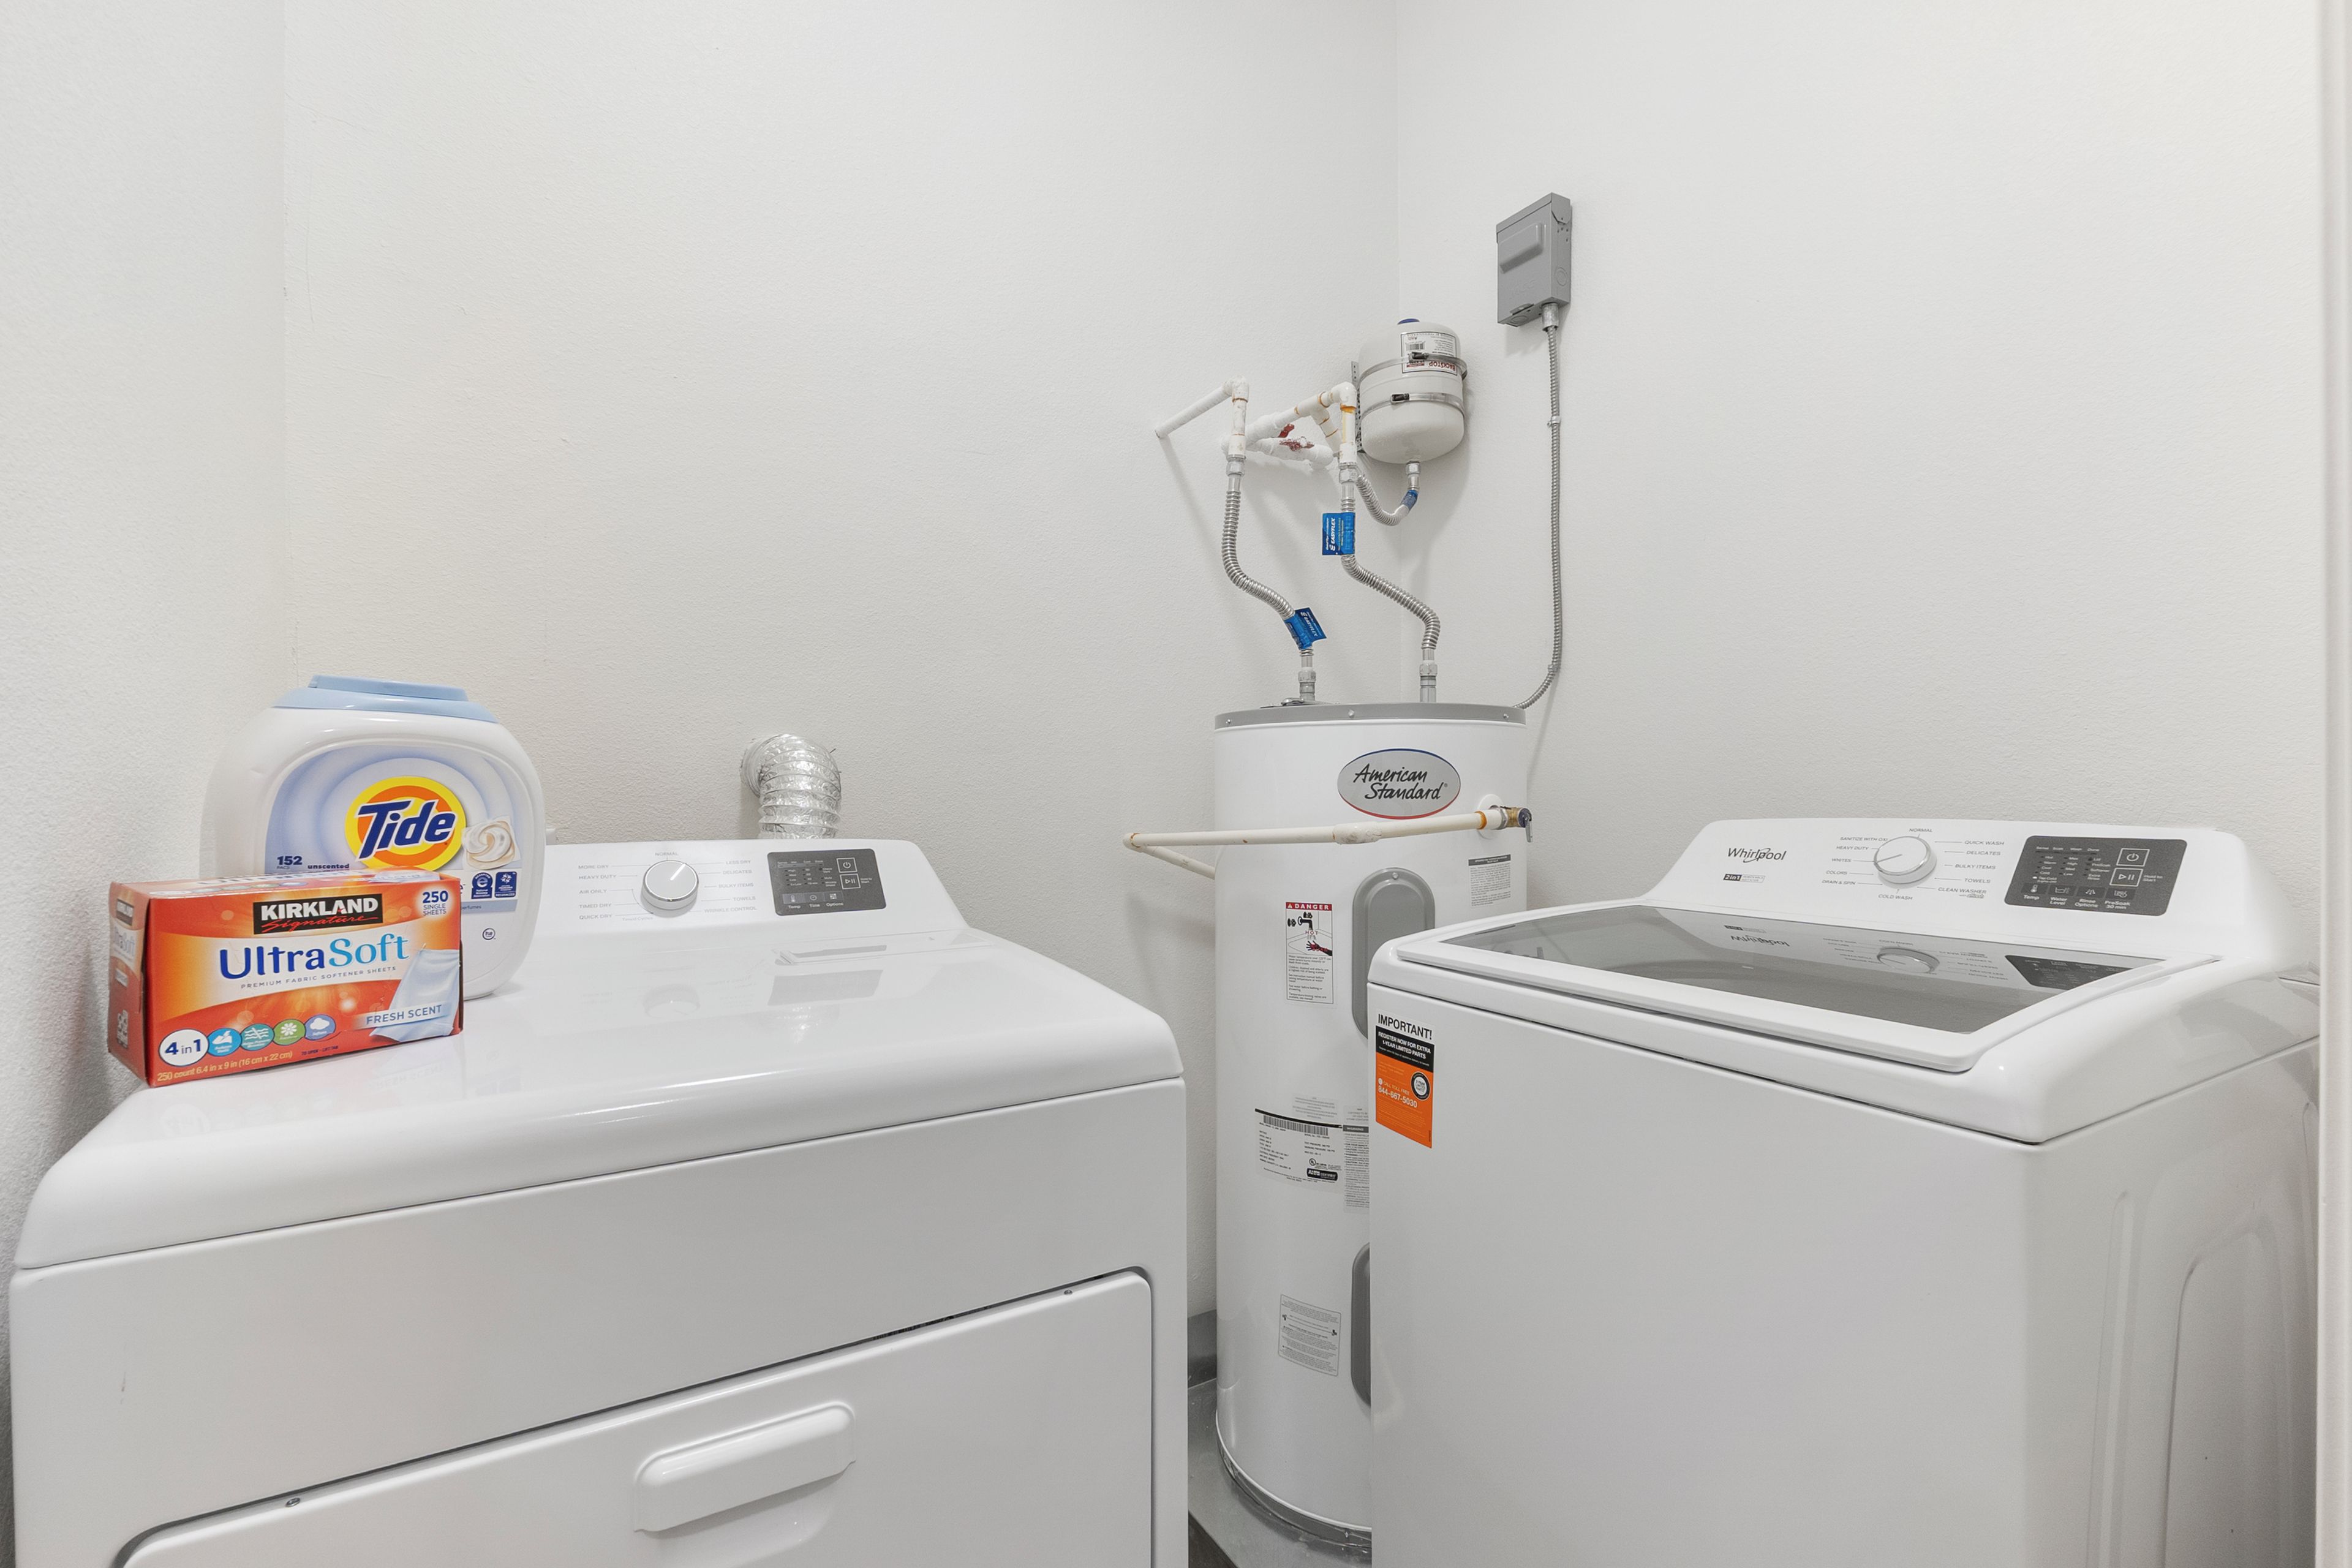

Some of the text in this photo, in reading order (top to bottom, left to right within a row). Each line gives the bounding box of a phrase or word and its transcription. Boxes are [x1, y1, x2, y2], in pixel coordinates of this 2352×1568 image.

[1429, 361, 1455, 371] BACKSTOP
[1353, 763, 1428, 783] American
[1365, 782, 1444, 799] Standard
[358, 800, 455, 859] Tide
[277, 856, 303, 865] 152
[1727, 847, 1787, 863] Whirlpool
[423, 891, 448, 903] 250
[261, 898, 379, 921] KIRKLAND
[262, 915, 379, 932] Signature
[241, 966, 396, 989] PREMIUM FABRIC SOFTENER SHEETS
[366, 1005, 442, 1025] FRESH SCENT
[1378, 1014, 1432, 1040] IMPORTANT!
[165, 1042, 179, 1055] 4
[181, 1045, 192, 1054] in
[194, 1039, 201, 1052] 1
[1378, 1031, 1396, 1042] REGISTER
[1417, 1044, 1431, 1054] EXTRA
[1396, 1045, 1412, 1054] LIMITED
[1412, 1050, 1426, 1059] PARTS
[157, 1072, 172, 1081] 250
[173, 1068, 195, 1079] count
[196, 1065, 208, 1074] 6.4
[238, 1058, 250, 1068] (16
[1378, 1085, 1417, 1108] 844-667-5030
